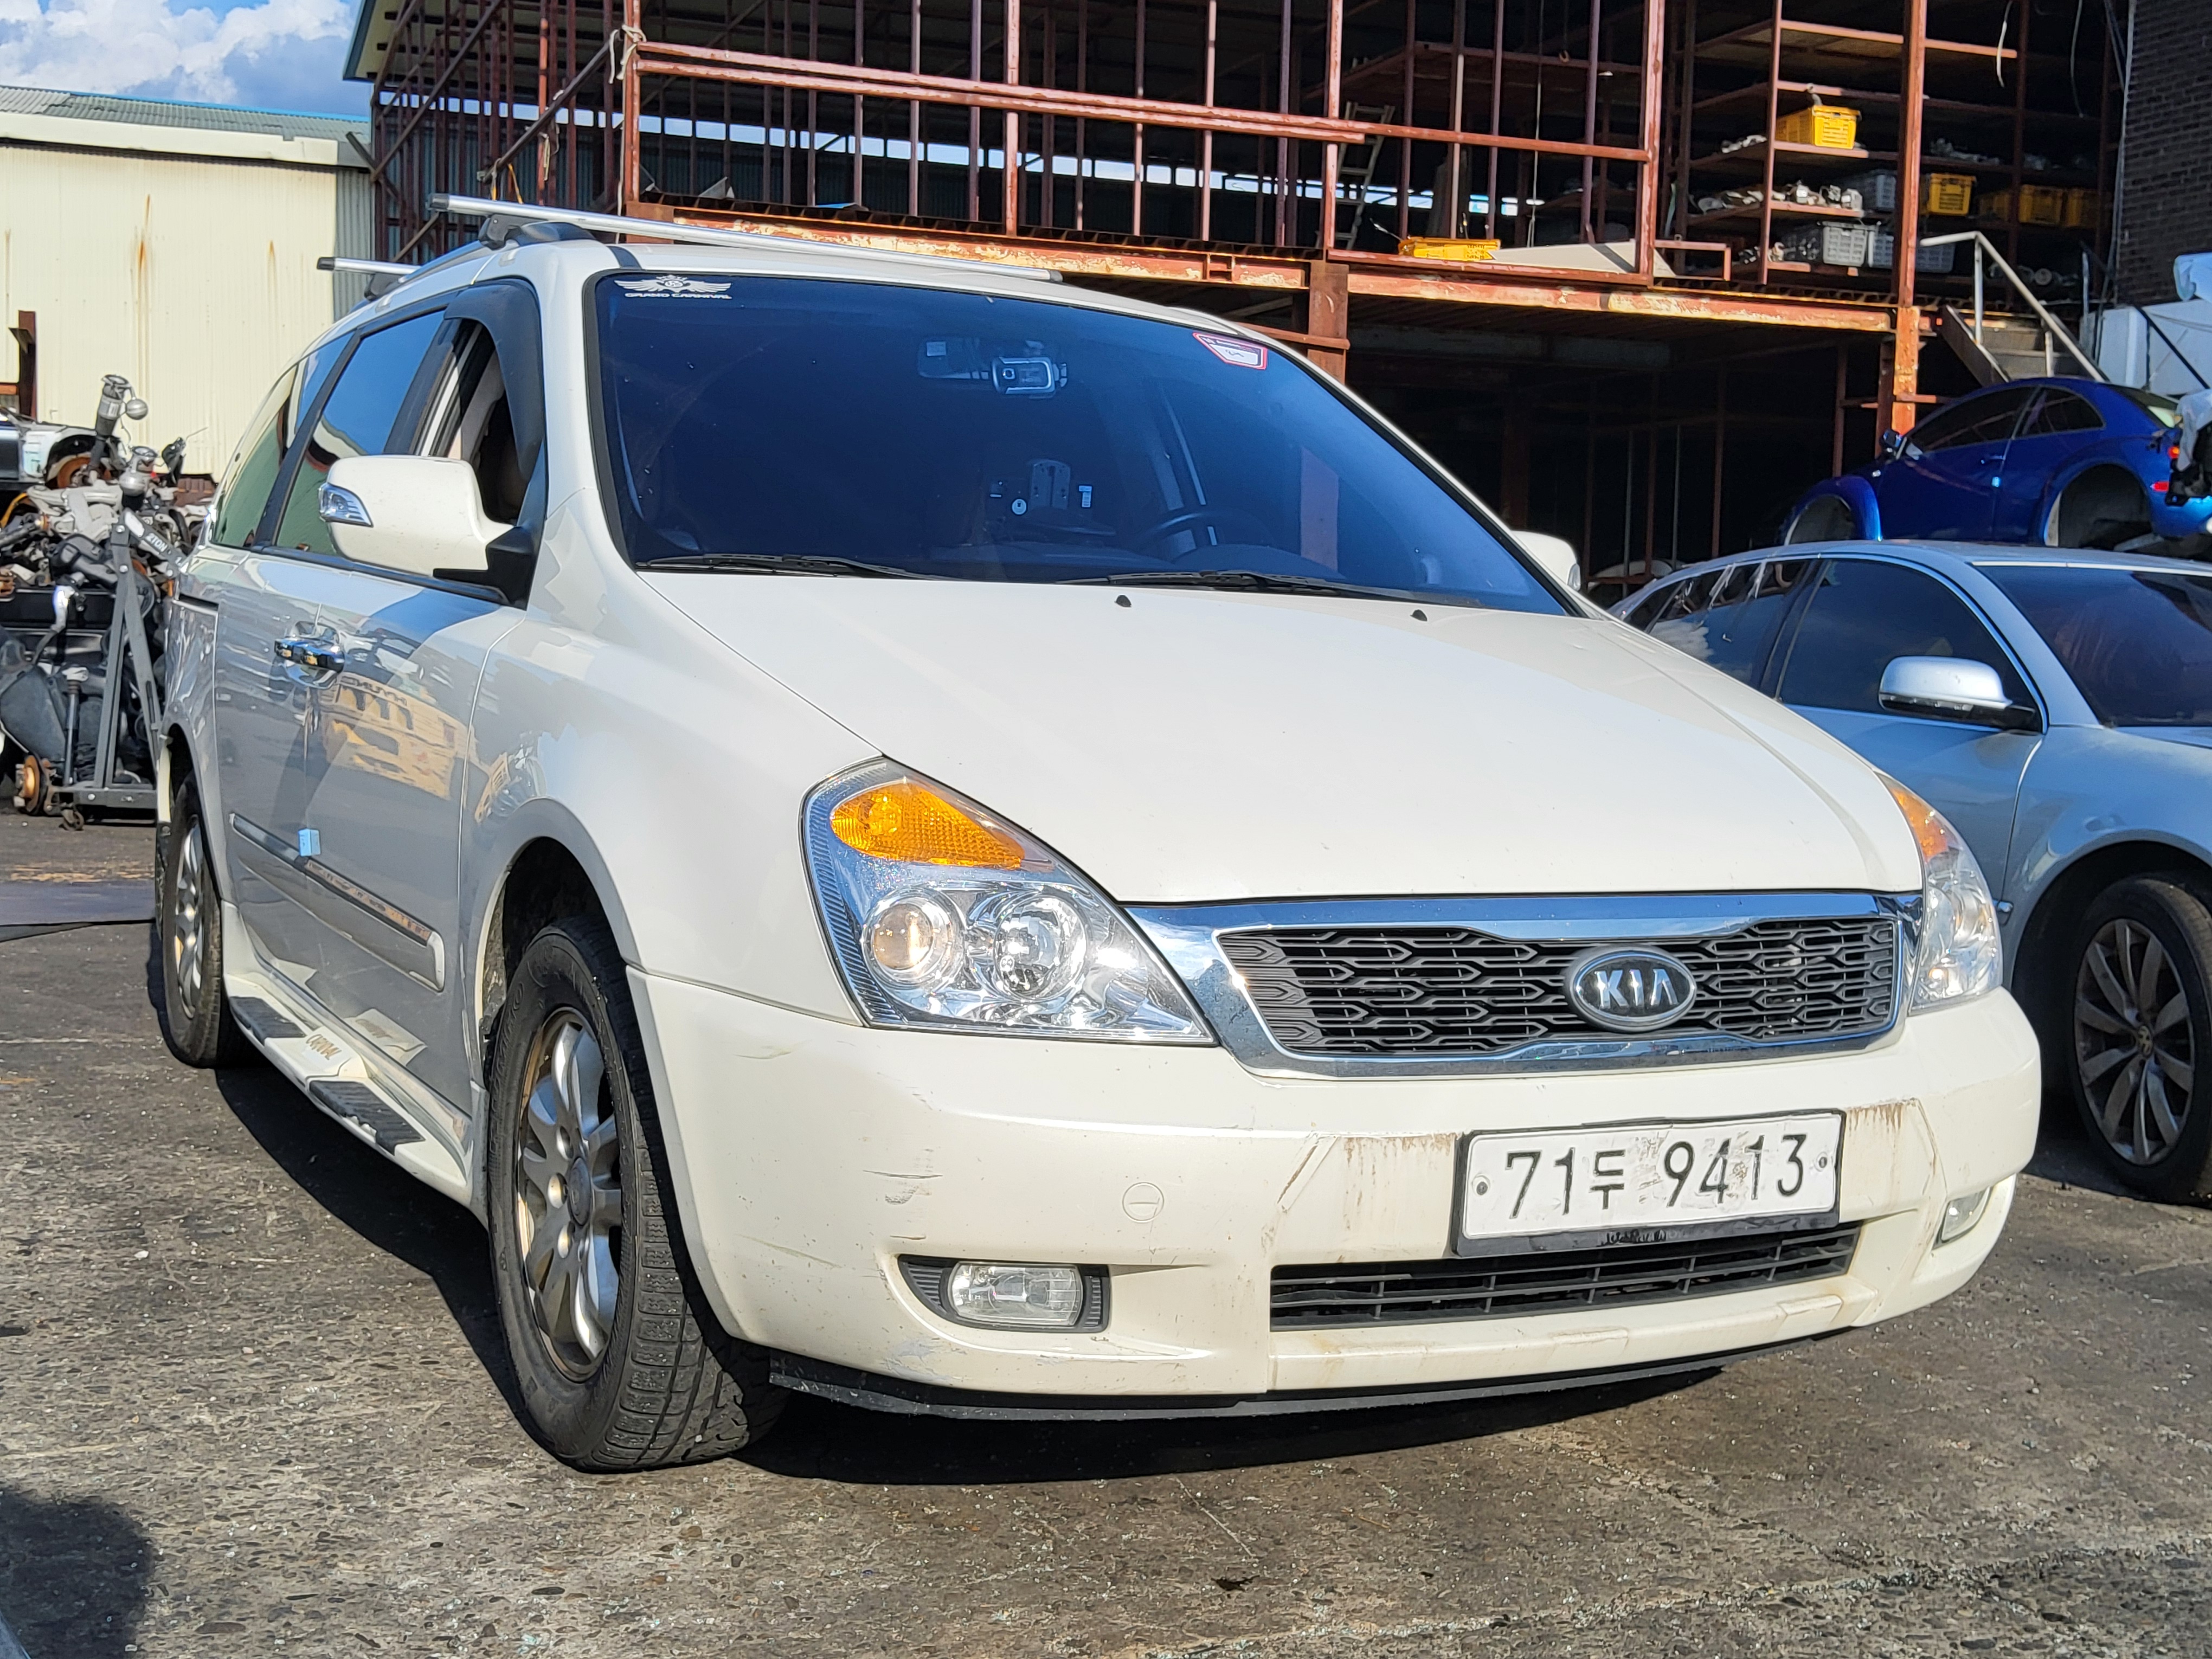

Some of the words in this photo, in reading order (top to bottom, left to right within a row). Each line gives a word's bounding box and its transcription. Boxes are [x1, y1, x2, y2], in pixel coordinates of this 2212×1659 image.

[146, 532, 168, 552] 2TON
[1594, 968, 1679, 1008] KIA
[1505, 1147, 1625, 1218] 71두
[1665, 1134, 1806, 1207] 9413
